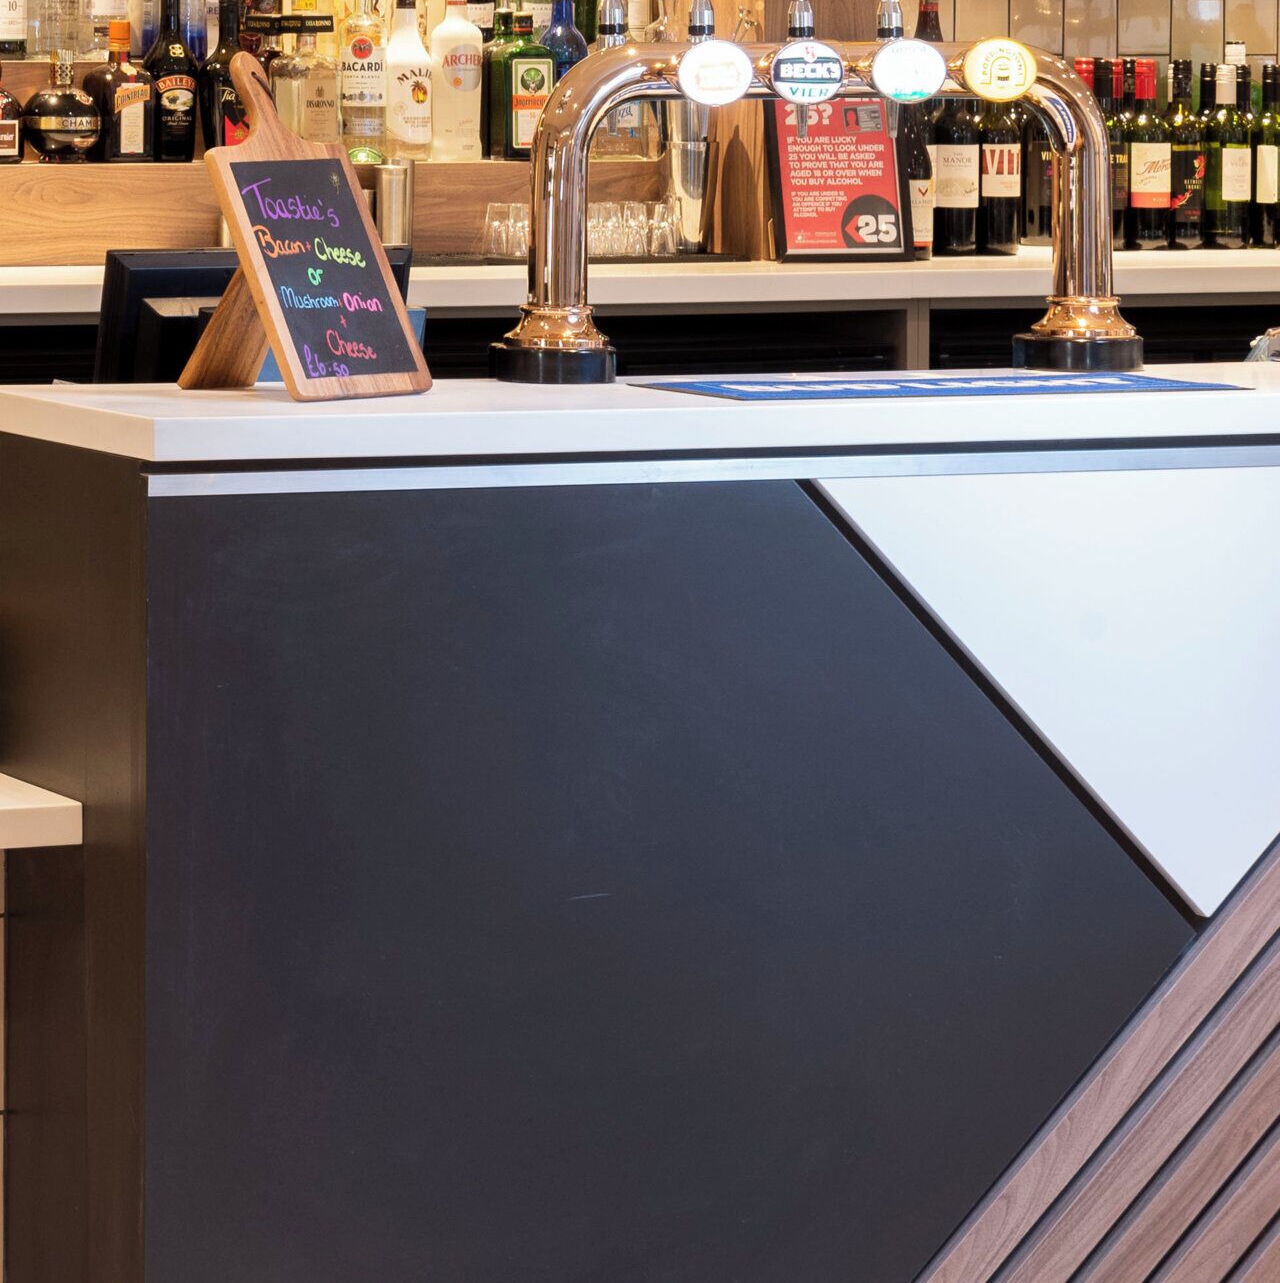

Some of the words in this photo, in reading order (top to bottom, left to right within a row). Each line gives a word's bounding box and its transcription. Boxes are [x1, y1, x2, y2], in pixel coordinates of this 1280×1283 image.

[8, 0, 18, 12] 10
[305, 19, 332, 27] DISARONNO
[306, 100, 335, 108] DISARONNO
[787, 136, 795, 144] IF
[796, 136, 813, 144] YOU
[814, 136, 830, 144] ARE
[831, 136, 857, 144] LUCKY
[787, 144, 822, 152] ENOUGH
[822, 144, 834, 152] TO
[835, 144, 857, 152] LOOK
[858, 144, 885, 152] UNDER
[788, 153, 798, 161] 25
[799, 153, 817, 161] YOU
[817, 153, 837, 161] WILL
[838, 153, 849, 161] BE
[850, 153, 876, 161] ASKED
[942, 156, 972, 164] MANOR
[789, 161, 801, 169] TO
[802, 161, 828, 169] PROVE
[829, 161, 849, 169] THAT
[850, 161, 867, 169] YOU
[868, 161, 884, 169] ARE
[790, 169, 812, 177] AGED
[813, 169, 822, 177] 18
[822, 169, 834, 177] OR
[835, 169, 857, 177] OVER
[857, 169, 882, 177] WHEN
[790, 178, 808, 186] YOU
[808, 178, 825, 186] BUY
[826, 178, 864, 186] ALCOHOL
[241, 177, 340, 228] Toastie's
[251, 224, 305, 258] Bacon
[314, 237, 366, 268] Cheese
[279, 284, 339, 310] Mushroom
[326, 328, 378, 360] Cheese
